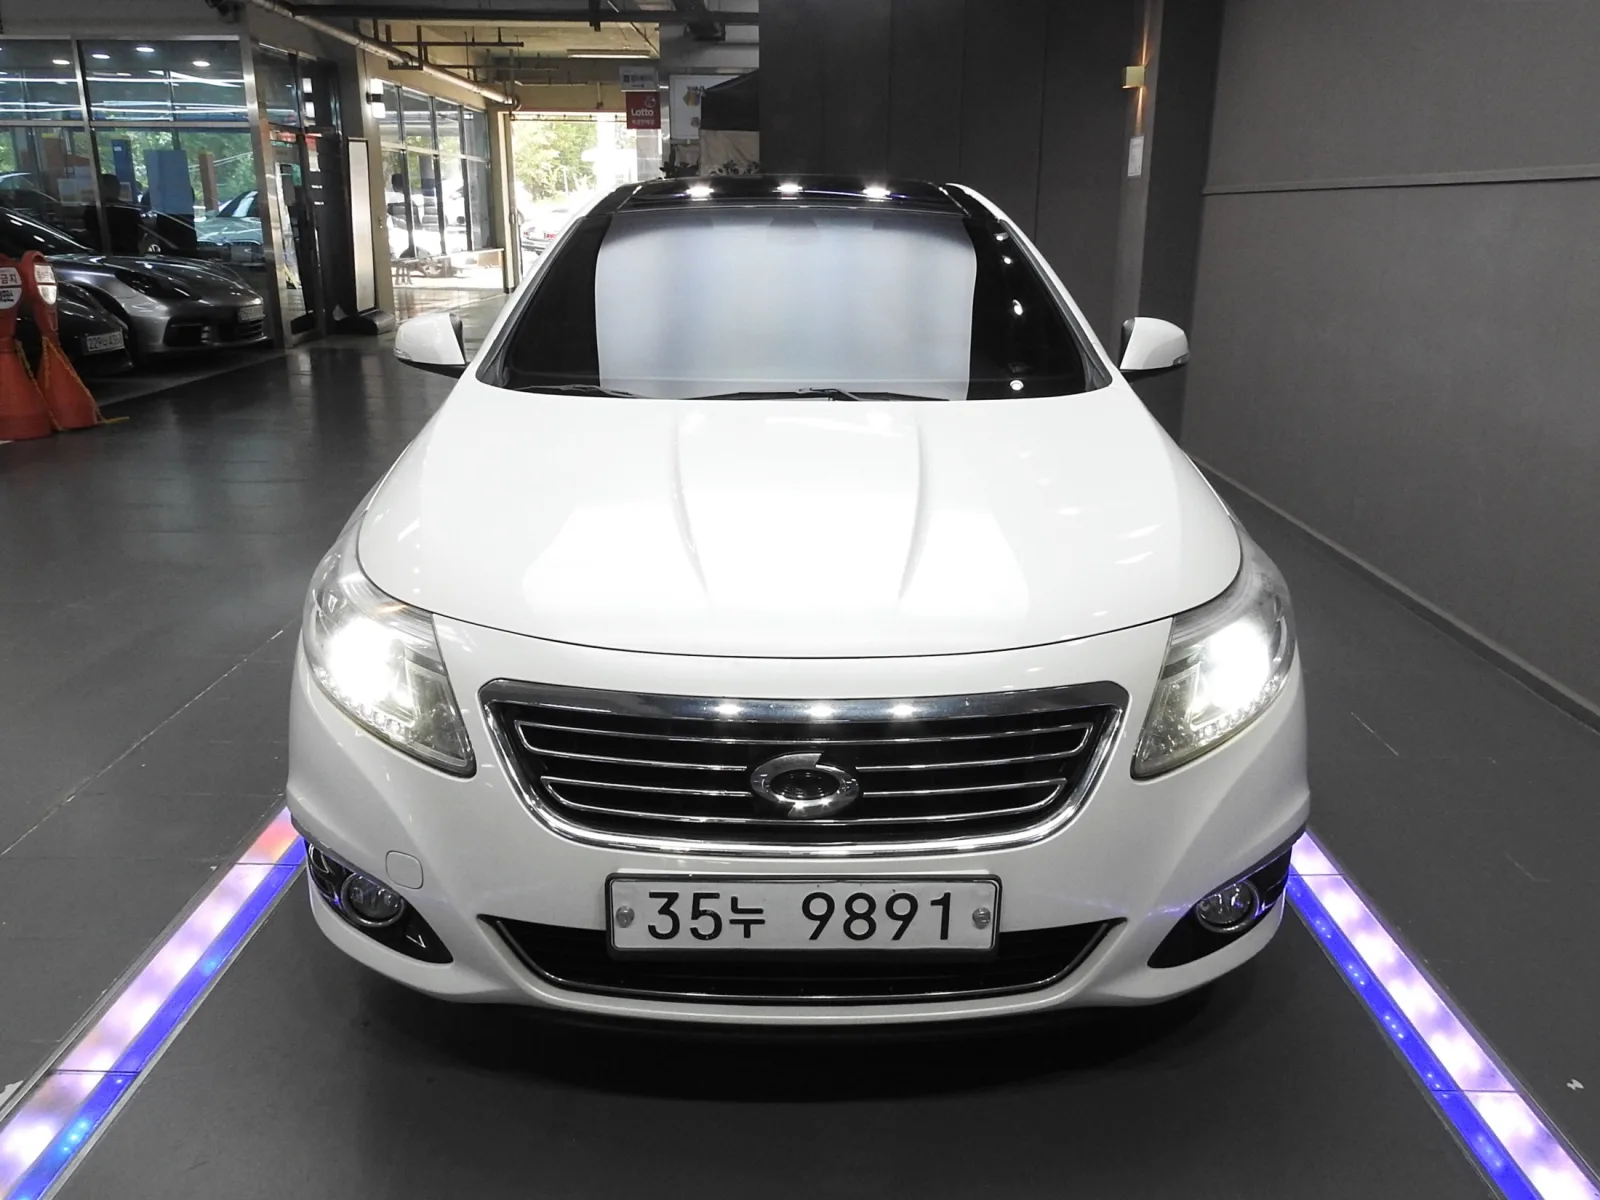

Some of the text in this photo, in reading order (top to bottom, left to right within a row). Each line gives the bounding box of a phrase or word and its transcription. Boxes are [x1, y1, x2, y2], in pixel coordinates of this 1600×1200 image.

[631, 108, 654, 117] Lotto
[647, 891, 952, 941] 35누 9891
